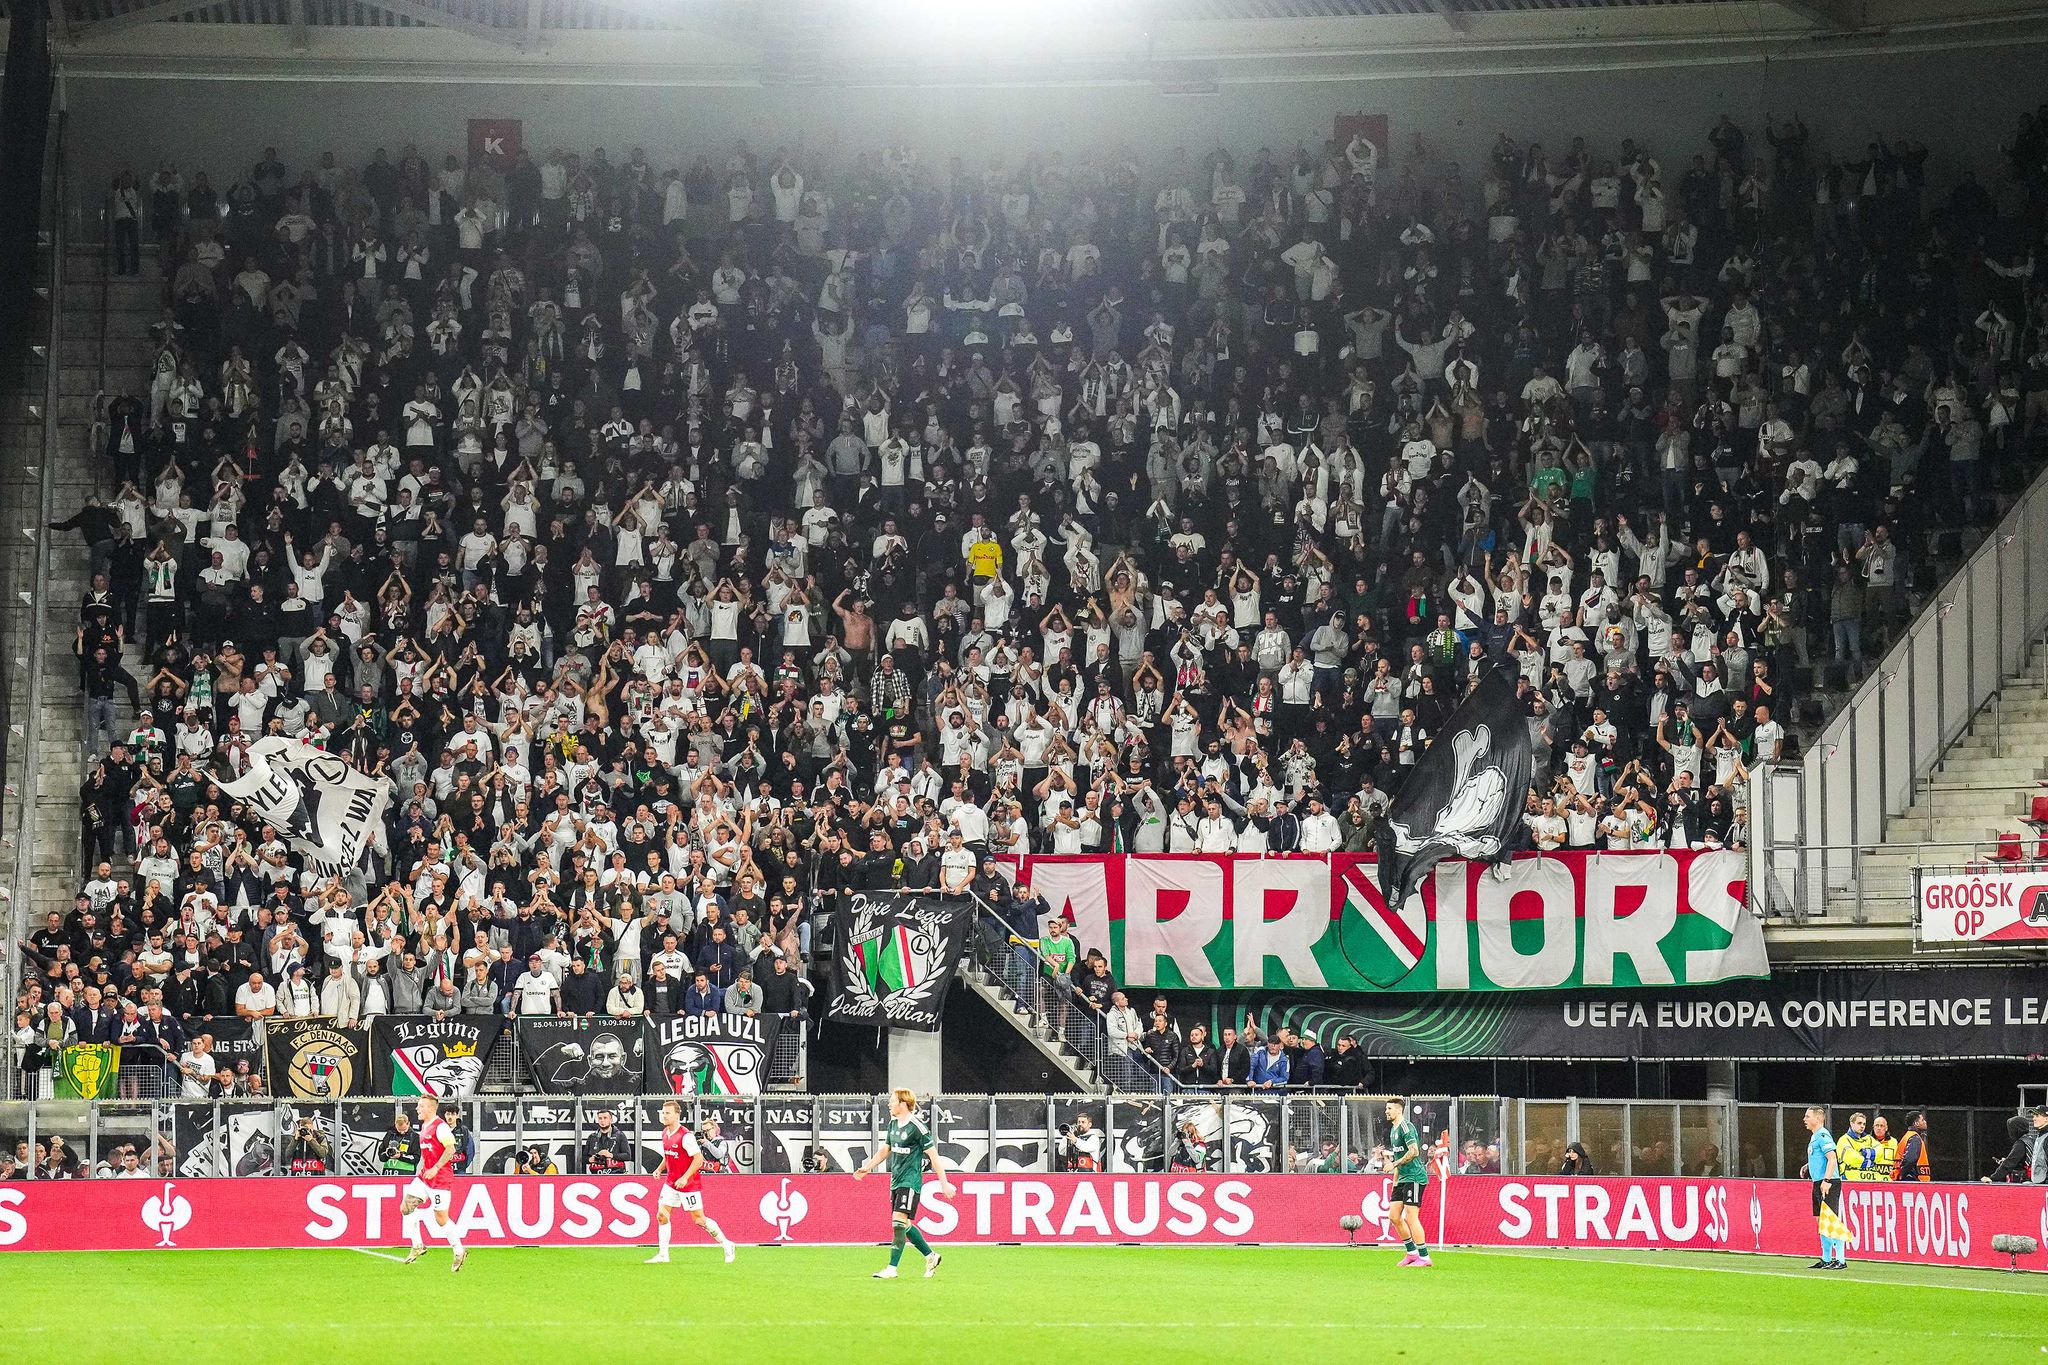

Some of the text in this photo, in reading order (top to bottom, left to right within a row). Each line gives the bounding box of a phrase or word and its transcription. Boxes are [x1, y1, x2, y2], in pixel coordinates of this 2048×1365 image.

[484, 137, 504, 154] K
[1926, 877, 2013, 910] GROÔSK
[895, 898, 953, 925] Legie
[1954, 910, 1985, 936] OP
[1563, 1001, 1648, 1028] UEFA
[1657, 1001, 1774, 1028] EUROPA
[1781, 998, 1992, 1028] CONFERENCE
[393, 1019, 481, 1044] Legijna
[660, 1014, 720, 1046] LEGIA
[303, 1181, 651, 1241] STRAUSS
[686, 1195, 697, 1207] 10
[918, 1179, 1255, 1239] STRAUSS
[1498, 1182, 1730, 1244] STRAUSS
[1902, 1191, 1970, 1258] TOOLS
